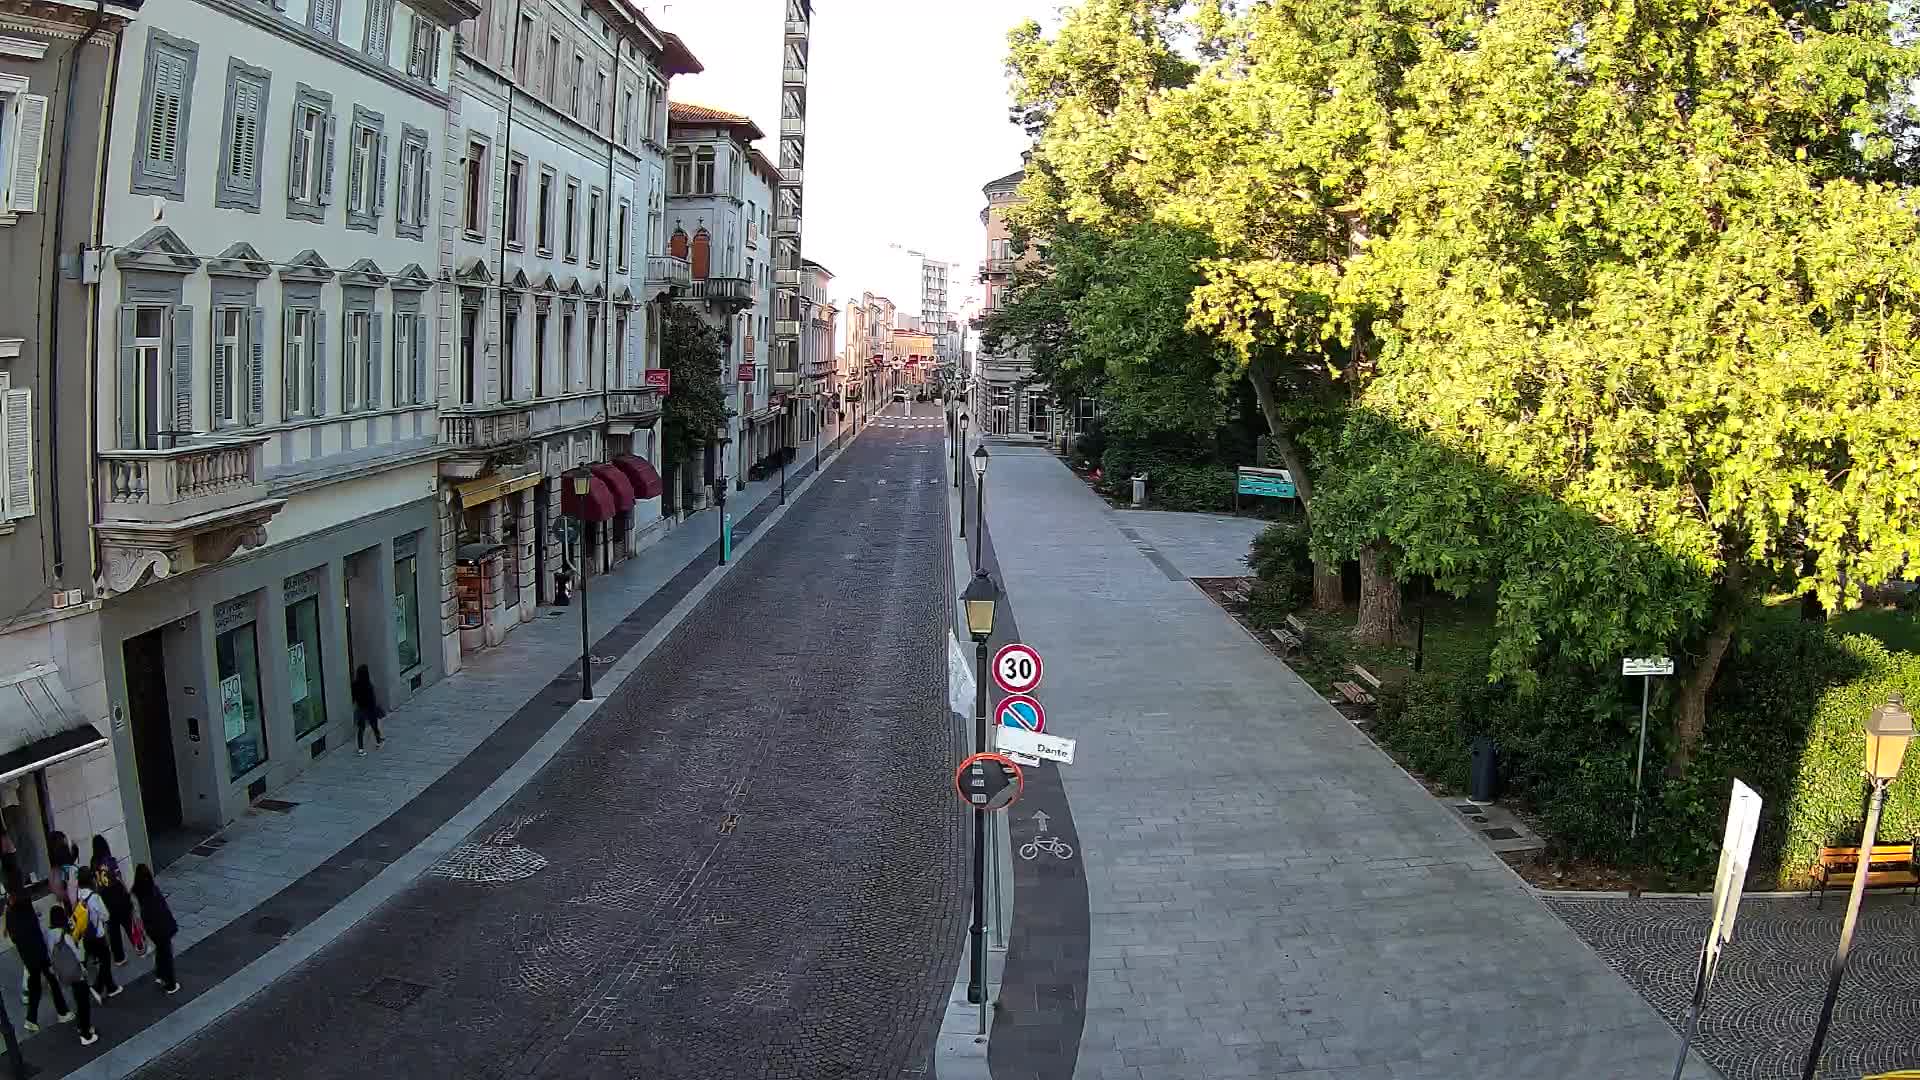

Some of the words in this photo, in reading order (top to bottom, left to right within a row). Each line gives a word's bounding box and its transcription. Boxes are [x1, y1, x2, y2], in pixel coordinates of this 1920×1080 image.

[1004, 658, 1032, 680] 30
[223, 678, 240, 700] 130
[1037, 744, 1069, 758] Dante
